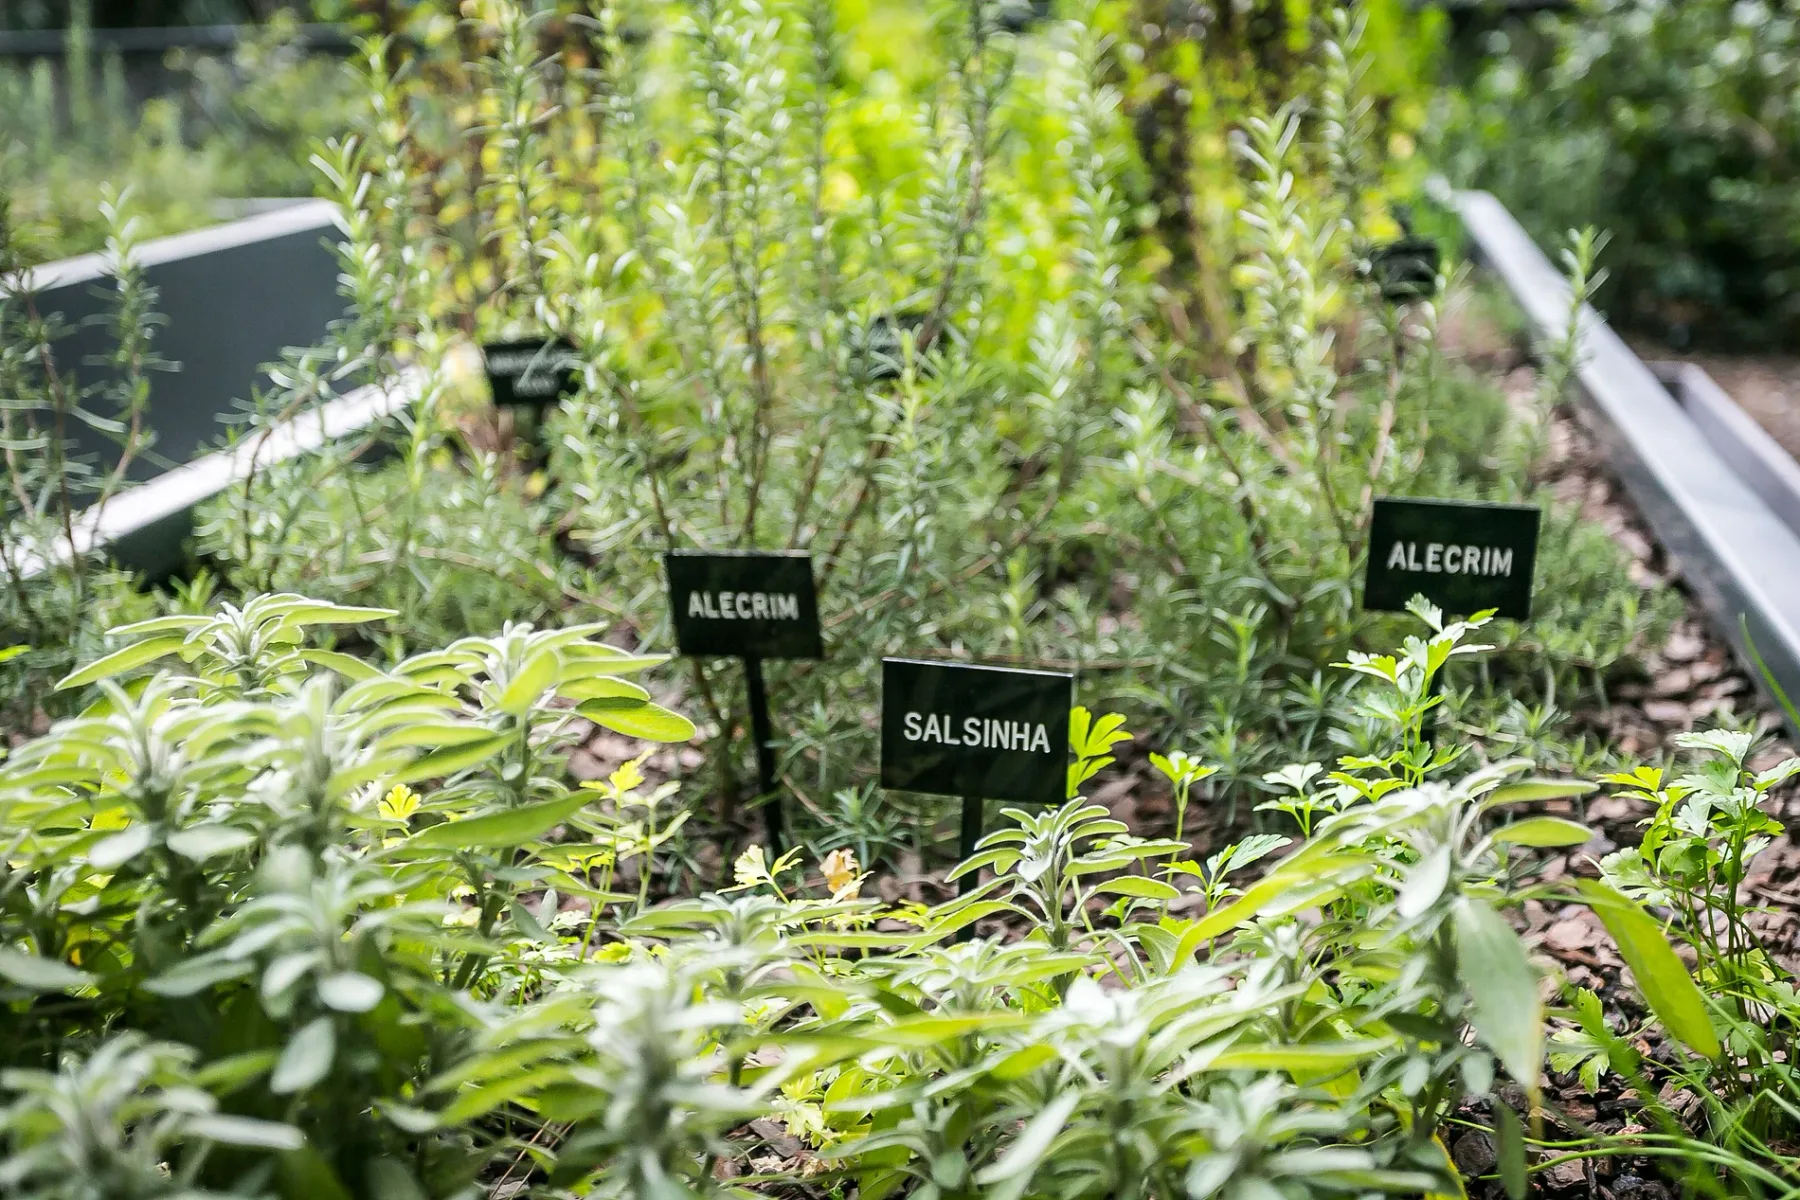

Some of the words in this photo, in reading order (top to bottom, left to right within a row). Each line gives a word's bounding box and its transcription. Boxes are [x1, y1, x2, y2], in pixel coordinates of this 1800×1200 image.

[1386, 540, 1513, 577] ALECRIM
[688, 590, 800, 621] ALECRIM
[903, 711, 1051, 754] SALSINHA
